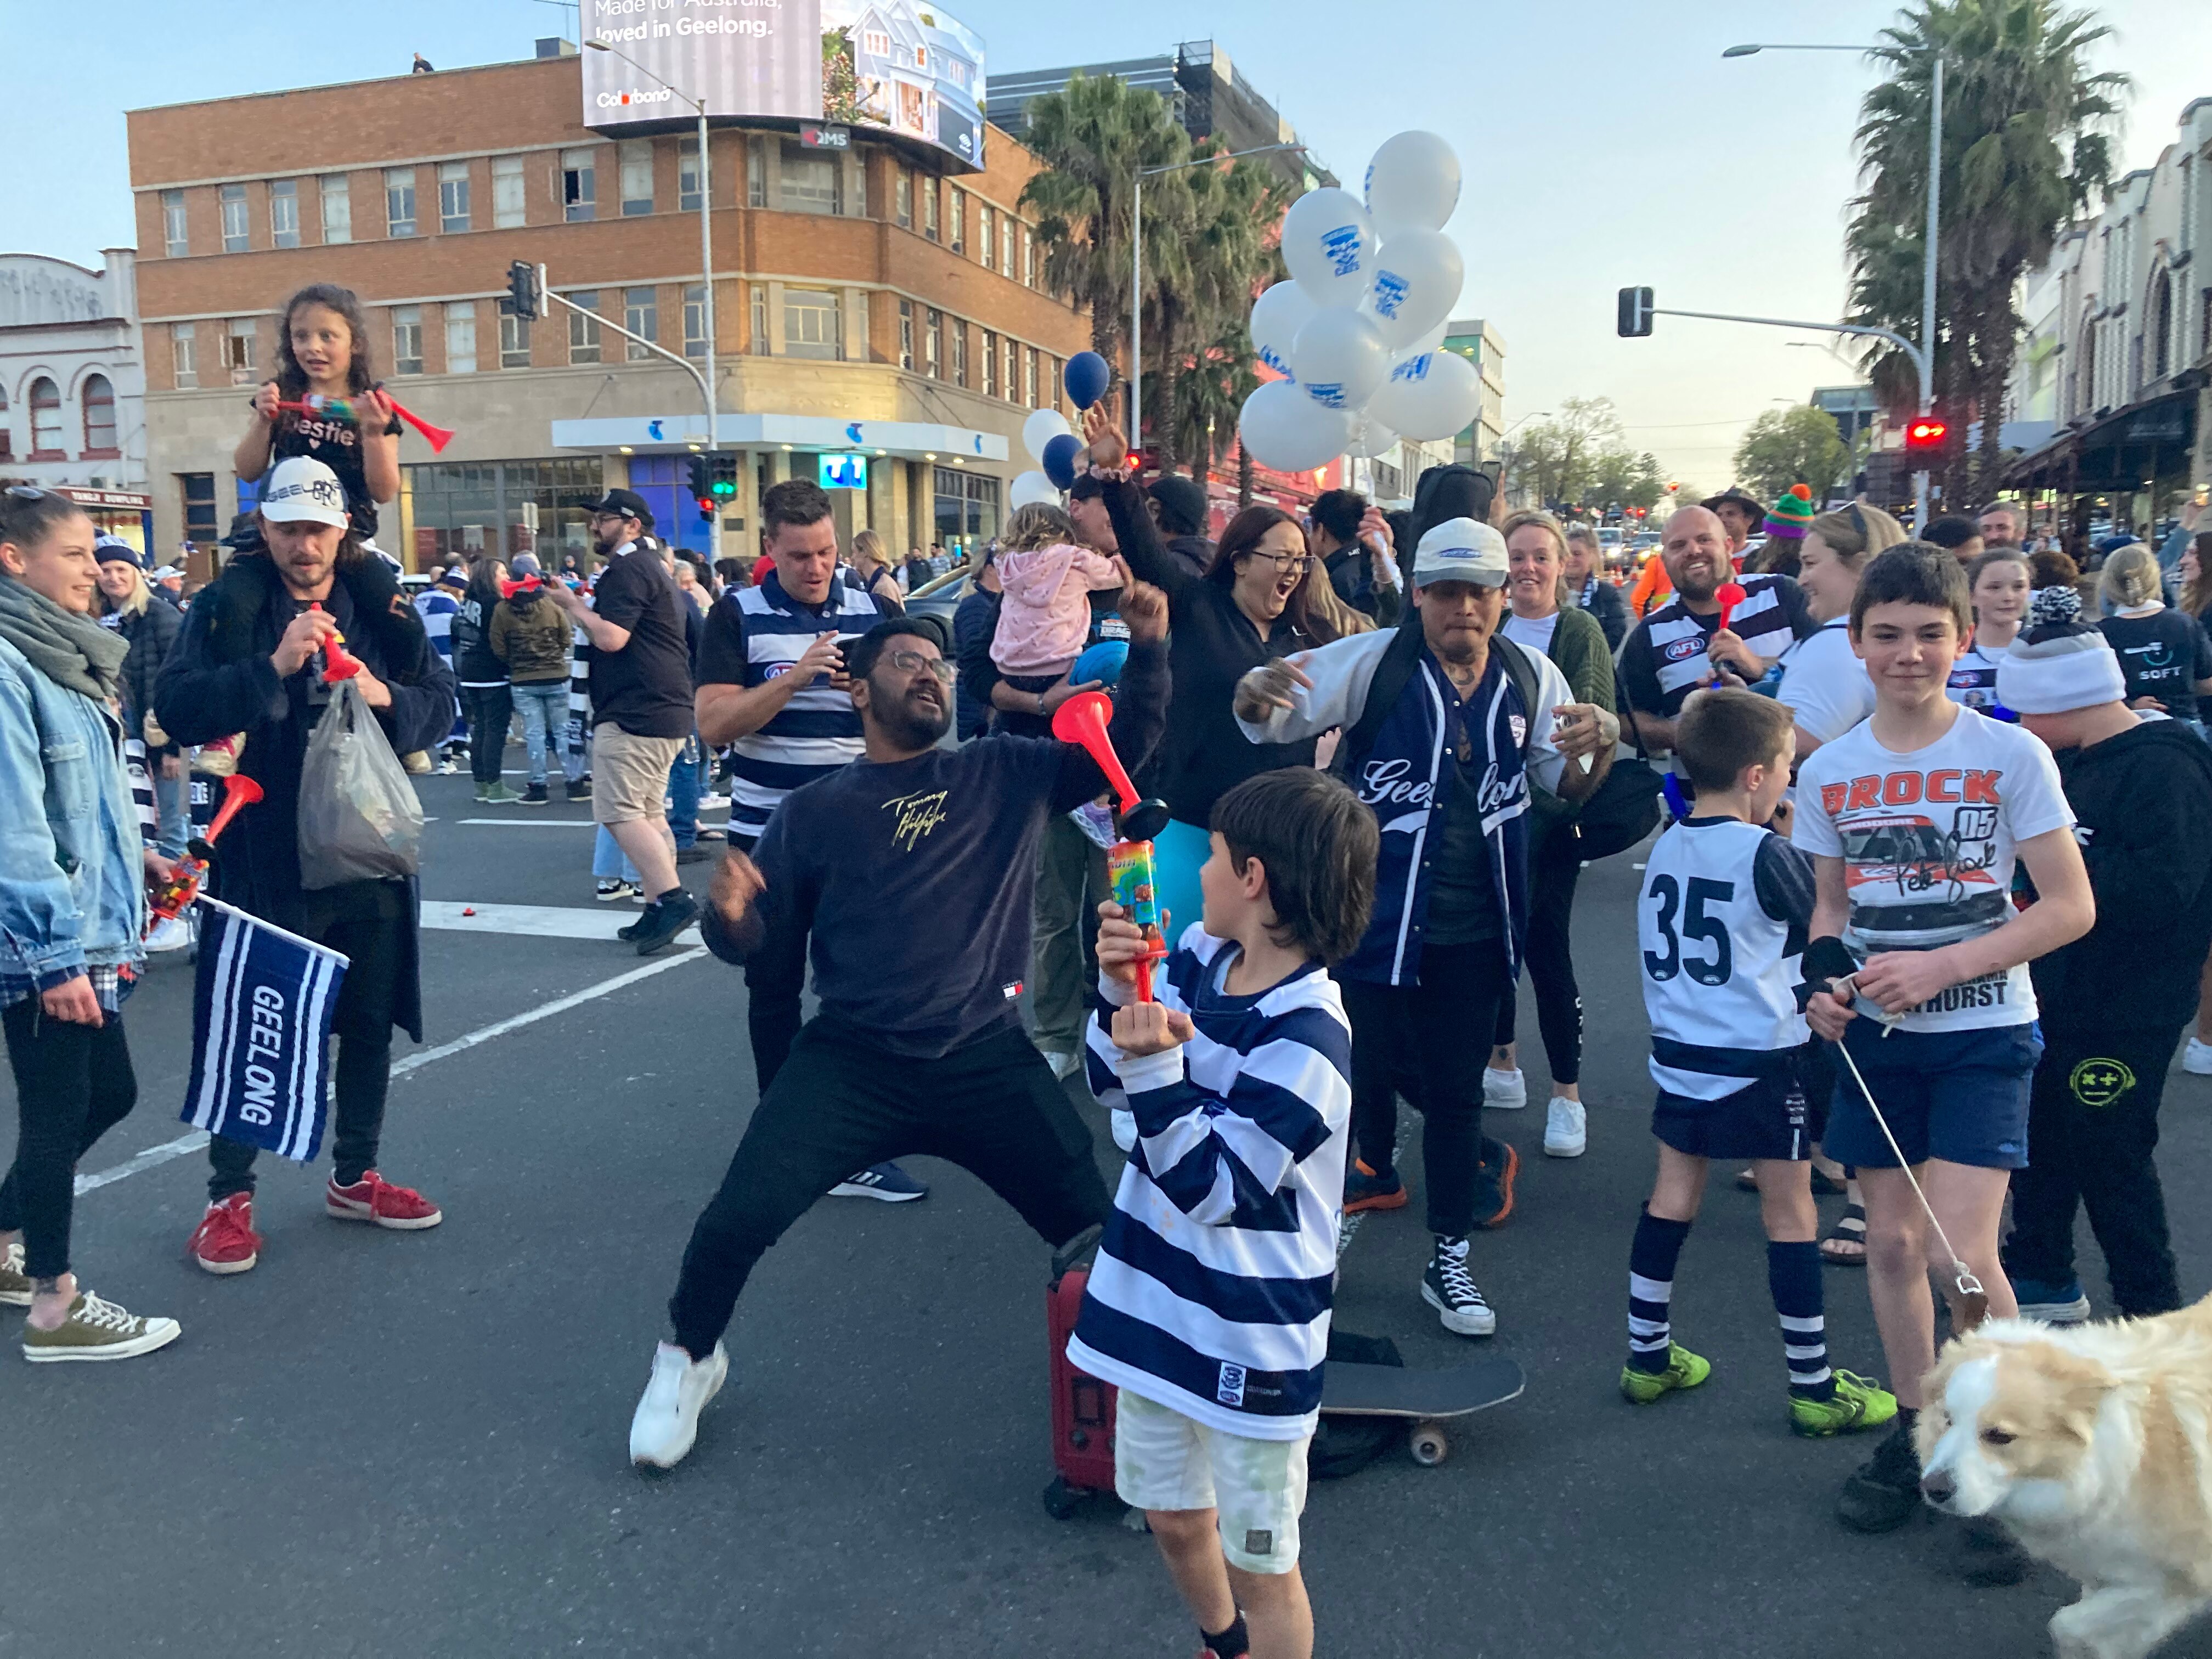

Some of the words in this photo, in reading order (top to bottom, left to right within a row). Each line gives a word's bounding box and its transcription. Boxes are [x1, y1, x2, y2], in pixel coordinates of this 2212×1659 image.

[595, 0, 646, 17] Made
[596, 21, 647, 43] loved
[653, 19, 671, 38] in
[676, 15, 773, 38] Geelong.
[294, 419, 356, 446] estie
[1671, 641, 1701, 656] AFL
[2139, 666, 2182, 680] SOFT
[1820, 769, 2004, 816] BROCK
[1957, 808, 1995, 839] 05
[1644, 873, 1735, 986] 35
[240, 985, 284, 1126] GEELONG
